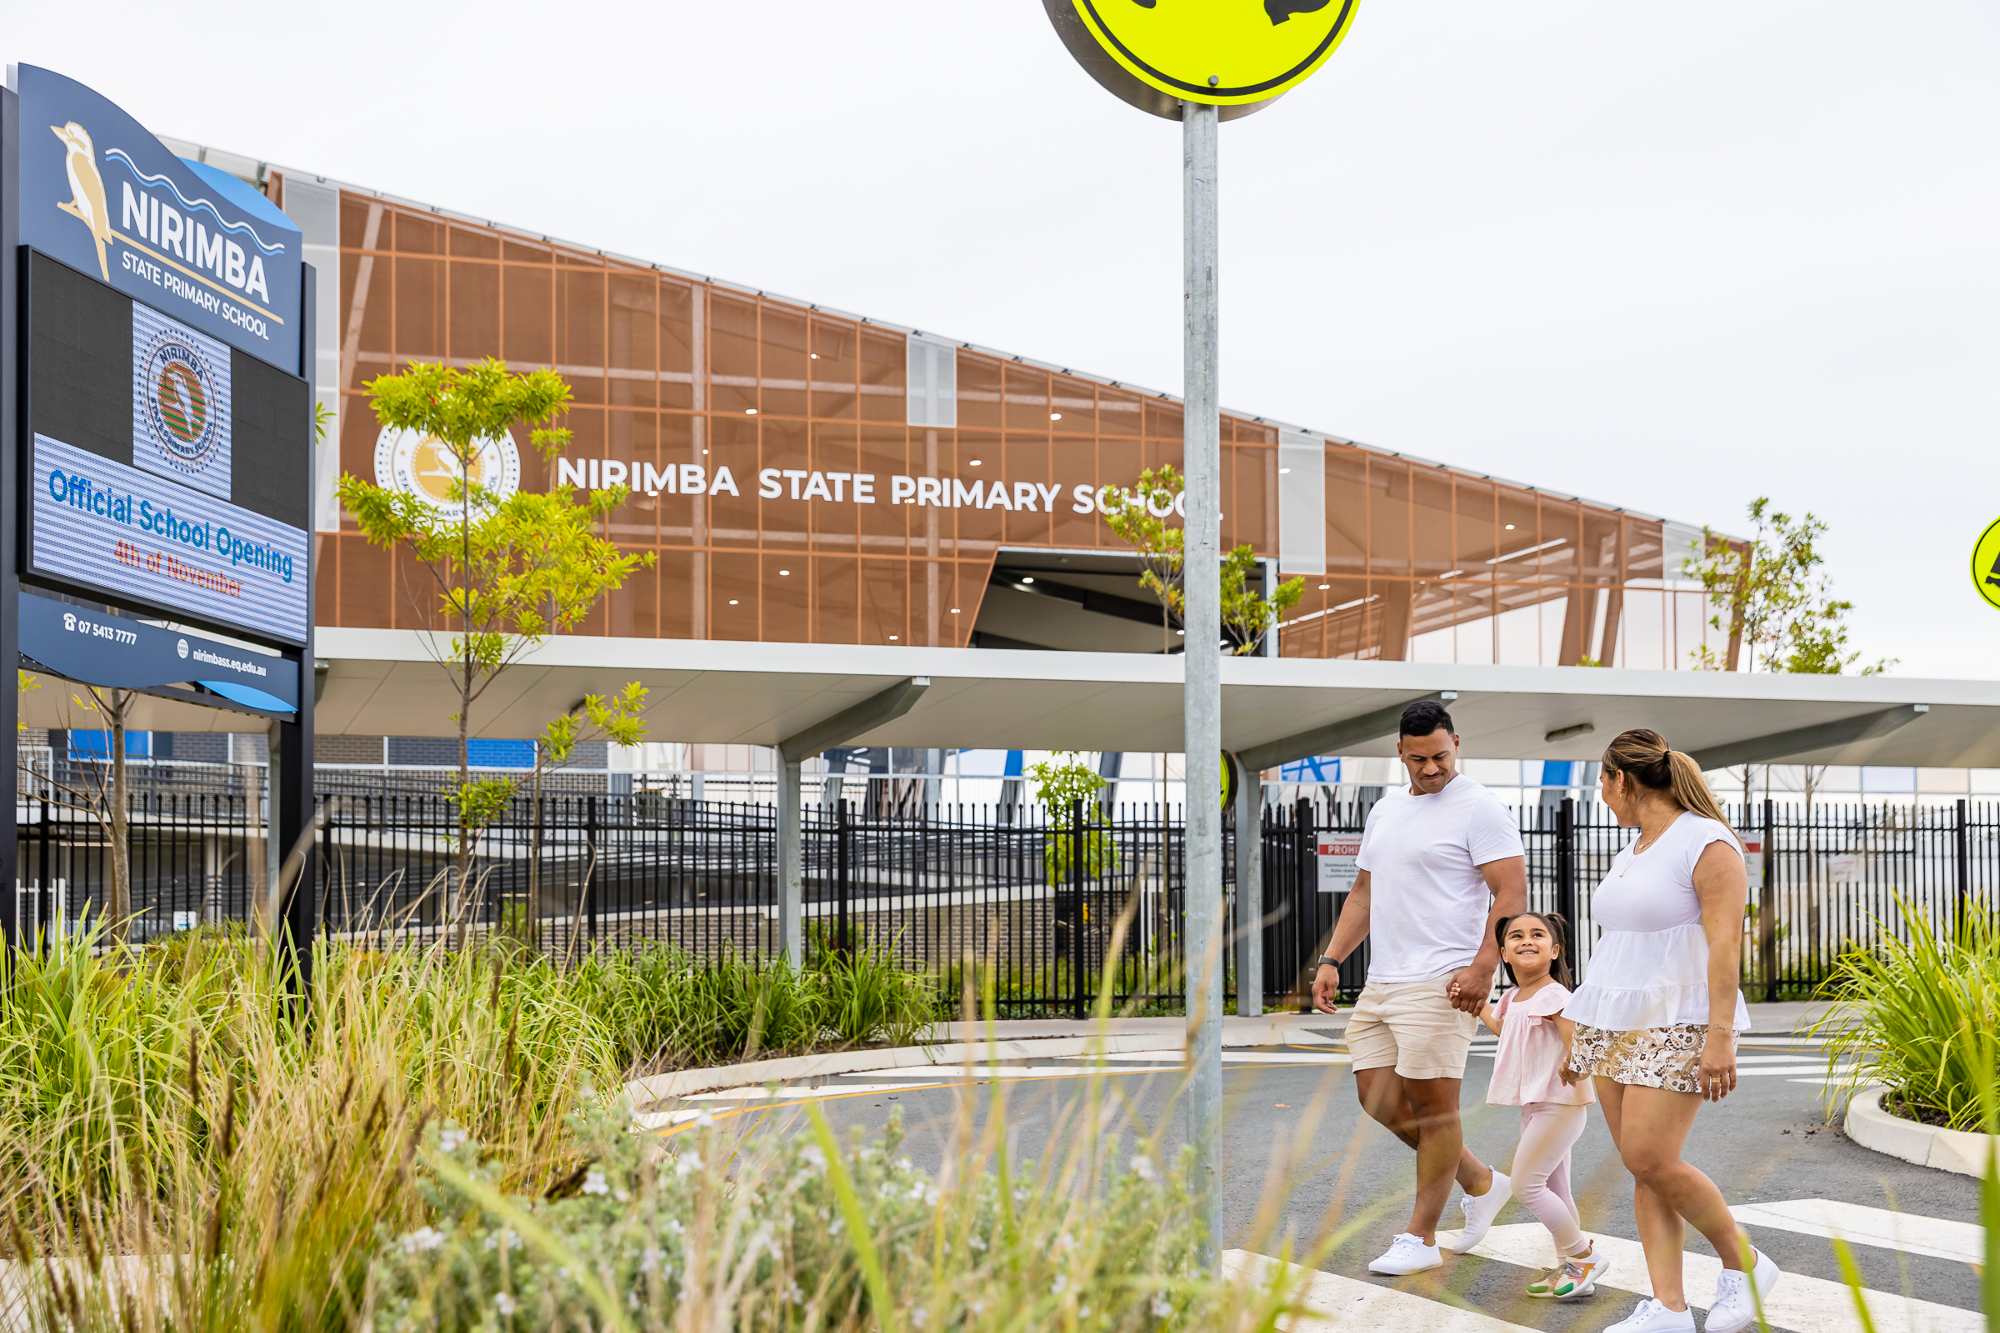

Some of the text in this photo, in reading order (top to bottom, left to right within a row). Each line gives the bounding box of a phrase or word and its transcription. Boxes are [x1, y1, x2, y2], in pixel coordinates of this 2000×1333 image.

[122, 180, 270, 304] NIRIMBA
[122, 251, 269, 340] STATE PRIMARY SCHOOL
[159, 348, 204, 381] NIRIMBA
[557, 457, 1224, 520] NIRIMBA STATE PRIMARY SCHO
[49, 469, 293, 583] Official School Opening
[114, 539, 241, 597] 4th of November
[78, 620, 137, 646] 07 5413 7777
[193, 650, 267, 677] nirimbass.eq.edu.au
[1327, 845, 1359, 855] PROHI
